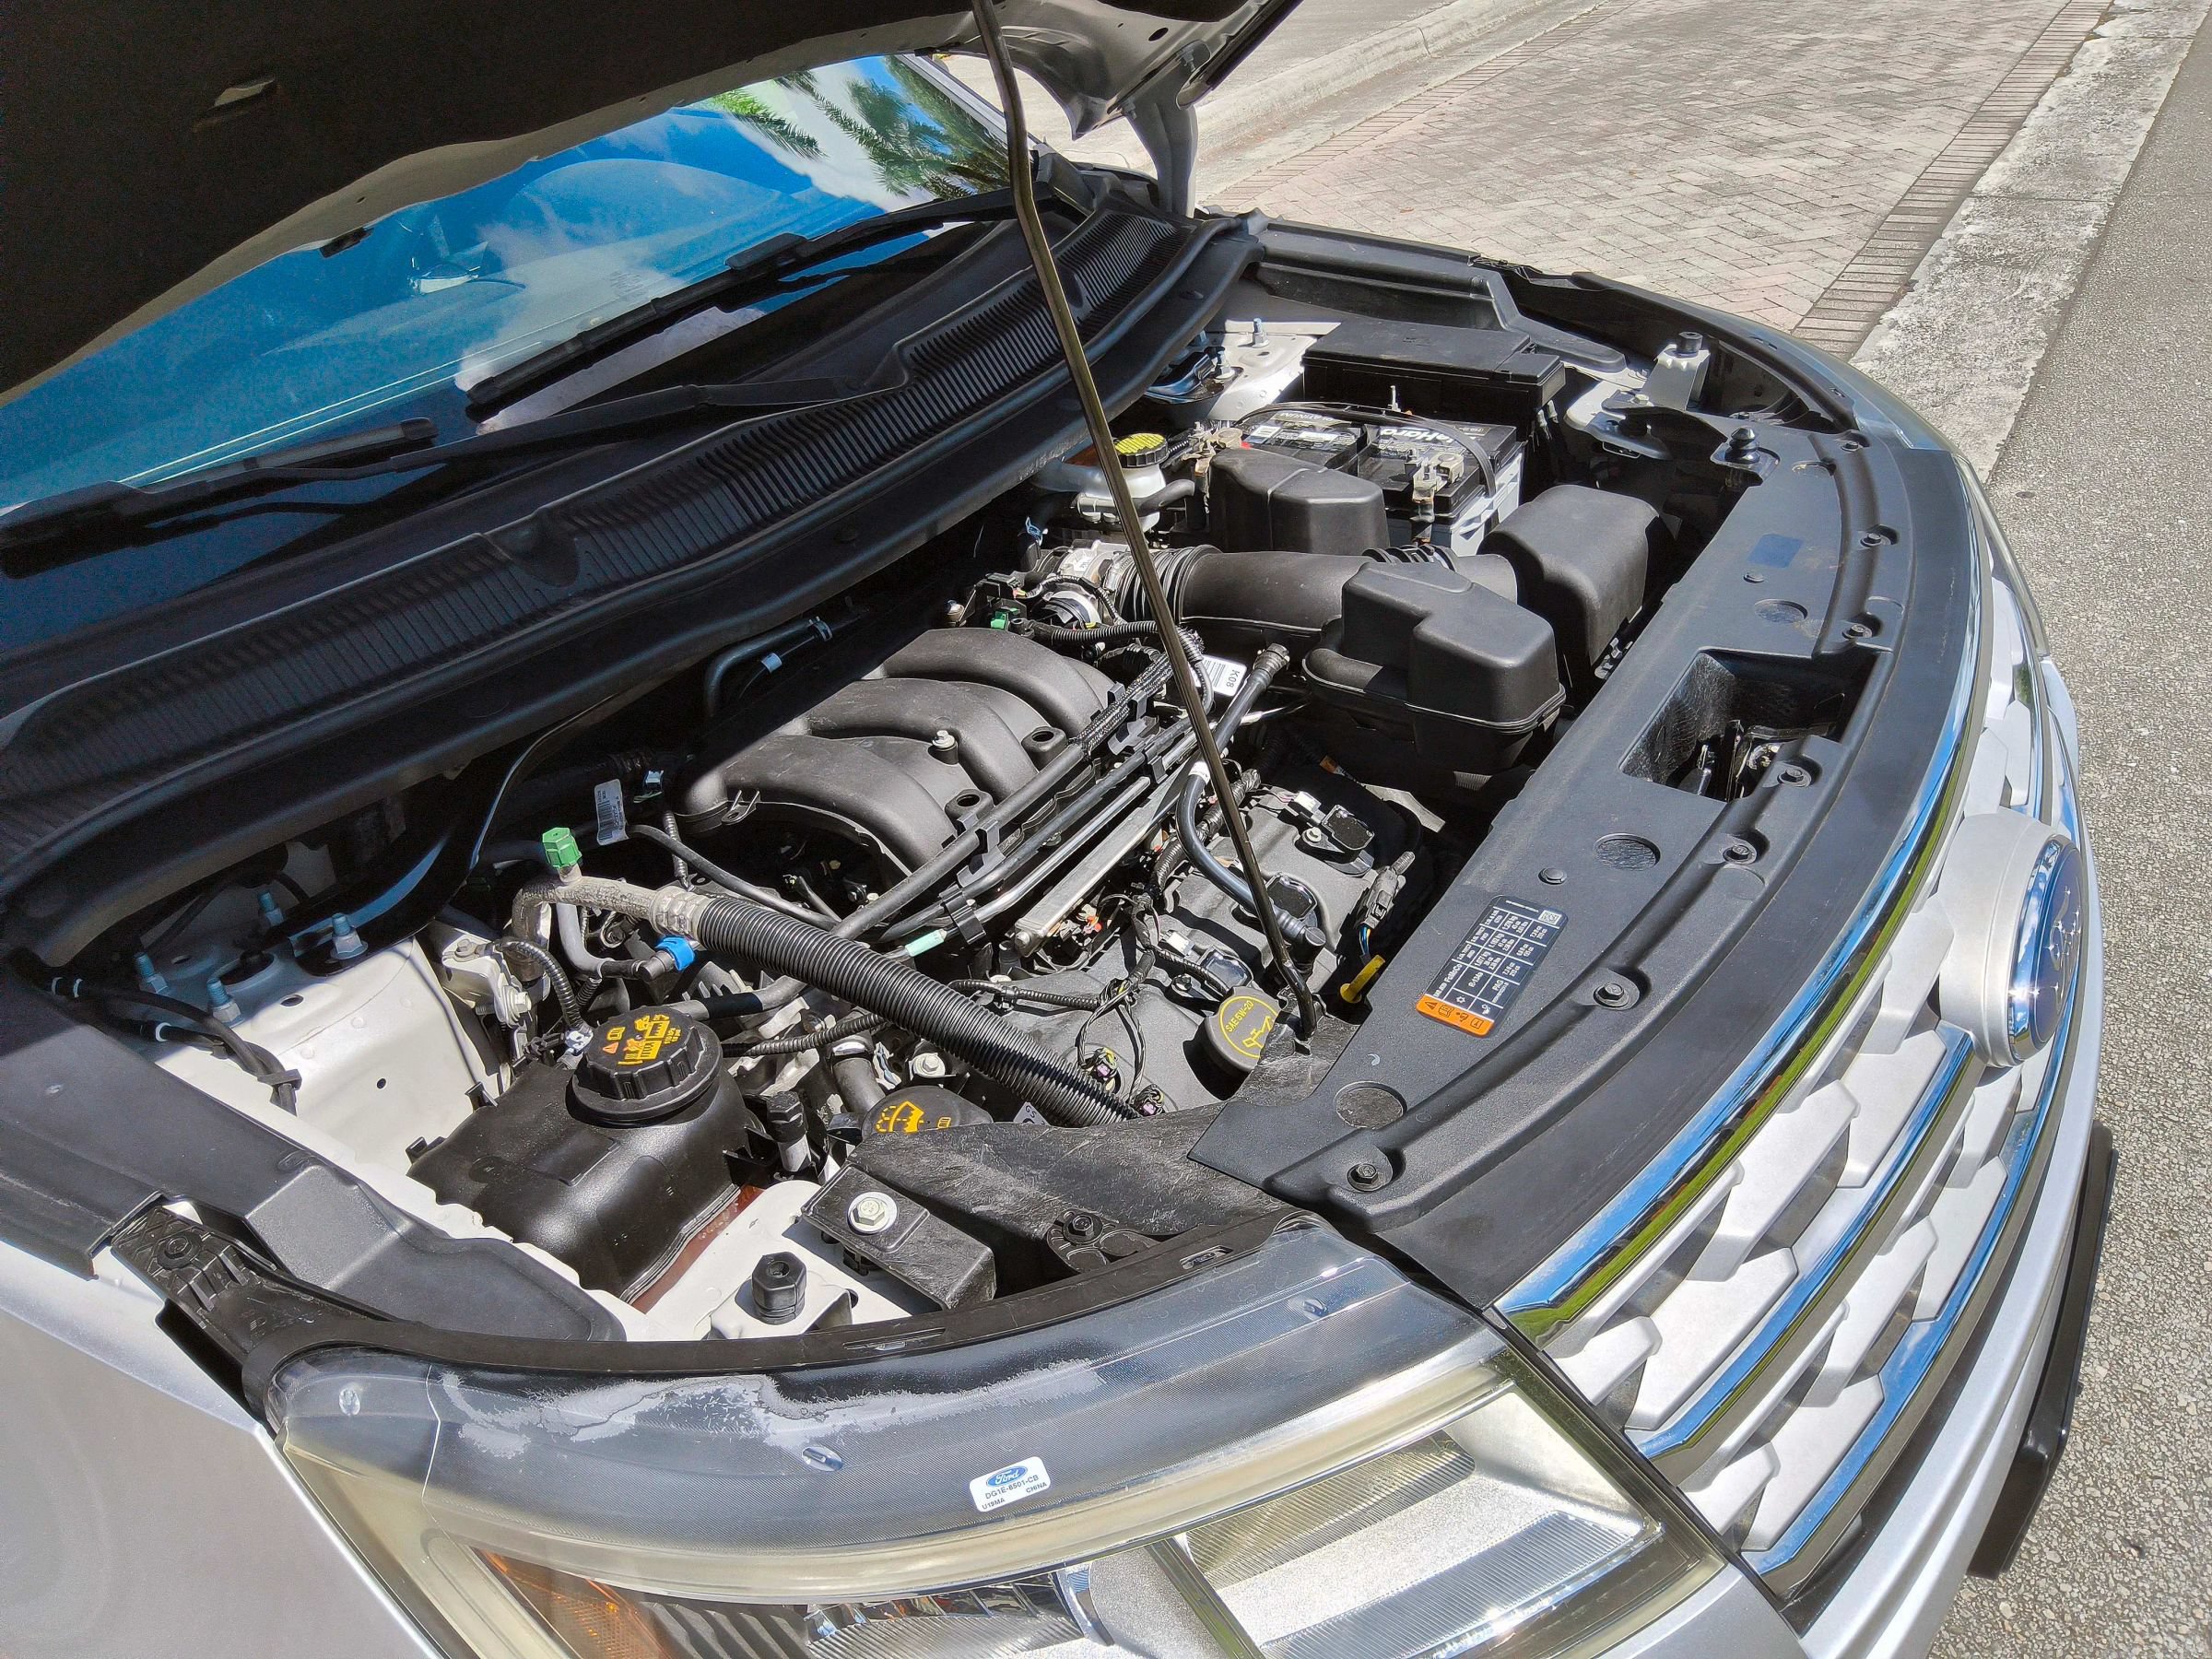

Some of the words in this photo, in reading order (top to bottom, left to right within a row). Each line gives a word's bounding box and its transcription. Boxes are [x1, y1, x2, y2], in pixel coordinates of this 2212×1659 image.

[1443, 962, 1462, 982] FoMoCo
[1491, 979, 1503, 991] PAG
[1226, 1018, 1239, 1032] SAE
[1235, 1000, 1253, 1020] 5W-20
[1026, 1482, 1048, 1493] CHINA
